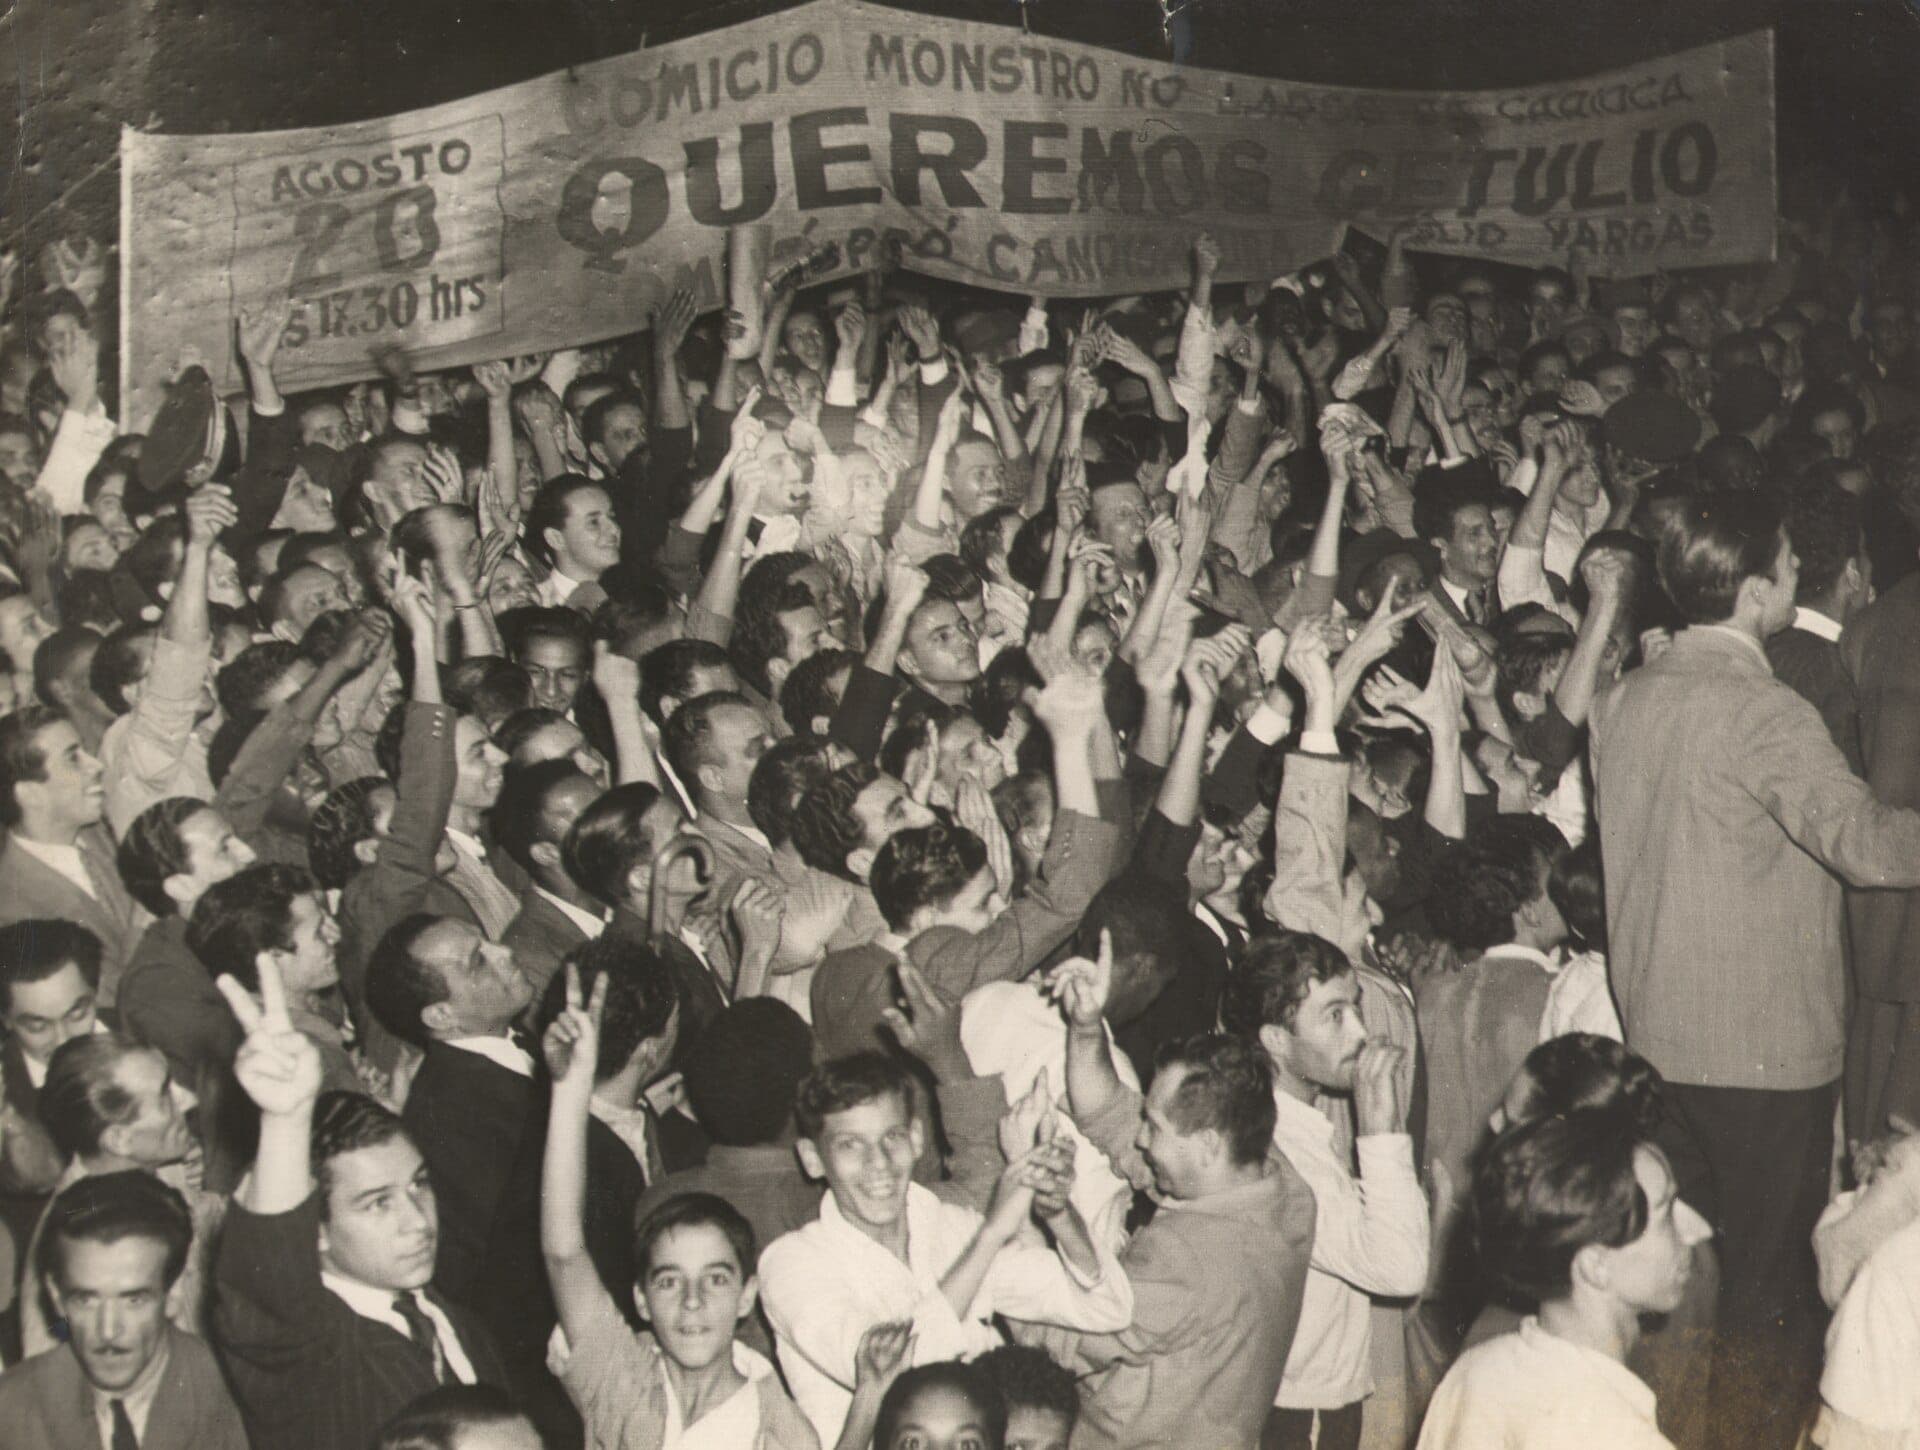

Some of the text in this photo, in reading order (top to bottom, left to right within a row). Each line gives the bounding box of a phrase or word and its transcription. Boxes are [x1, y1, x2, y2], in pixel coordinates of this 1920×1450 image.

[865, 33, 1099, 101] MONSTRO
[271, 139, 471, 202] AGOSTO
[556, 106, 1273, 274] QUEREMOS
[1313, 120, 1718, 218] GETULIO
[1545, 211, 1714, 255] VARGAS
[430, 273, 487, 321] hrs
